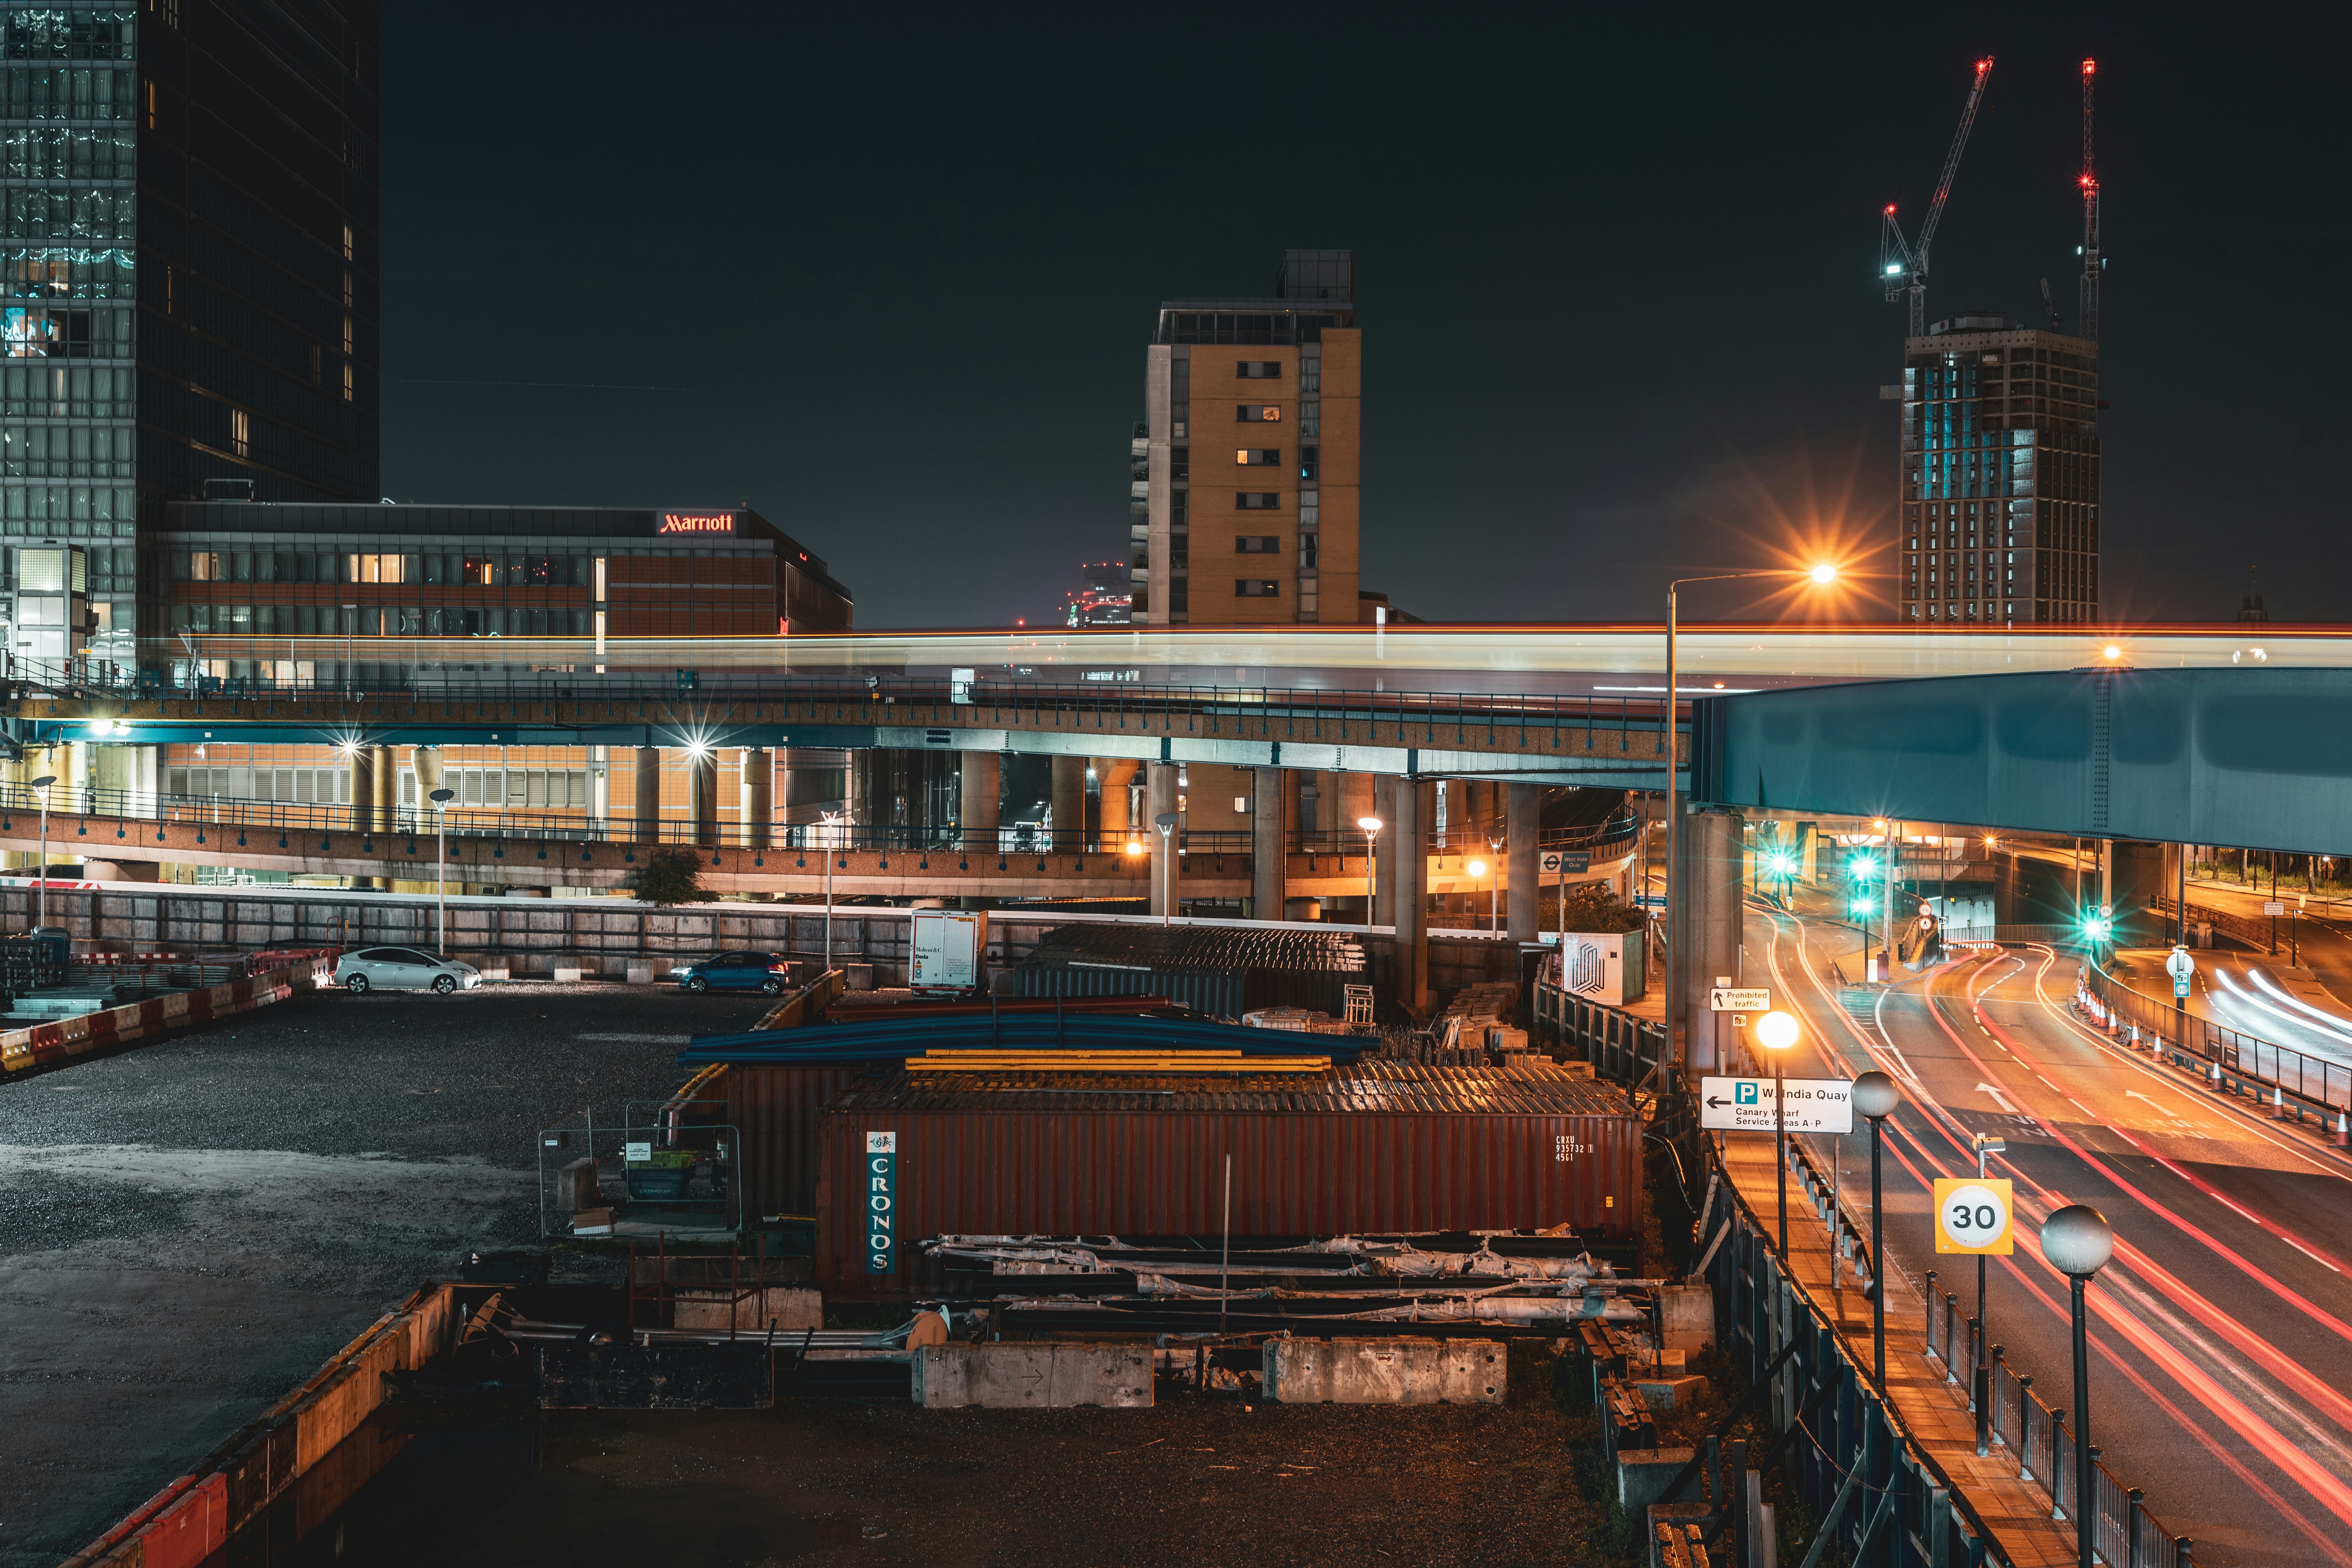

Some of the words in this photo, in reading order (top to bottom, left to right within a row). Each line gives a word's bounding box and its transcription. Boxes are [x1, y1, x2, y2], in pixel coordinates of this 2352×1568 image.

[660, 514, 732, 533] Marriott
[1741, 1084, 1755, 1102] P
[1783, 1089, 1811, 1098] India
[1817, 1090, 1847, 1101] Quay
[1736, 1108, 1768, 1117] Canary
[1556, 1136, 1574, 1144] CRXU
[1556, 1144, 1584, 1153] 935732
[871, 1158, 891, 1269] CRONOS
[1953, 1205, 1995, 1229] 30
